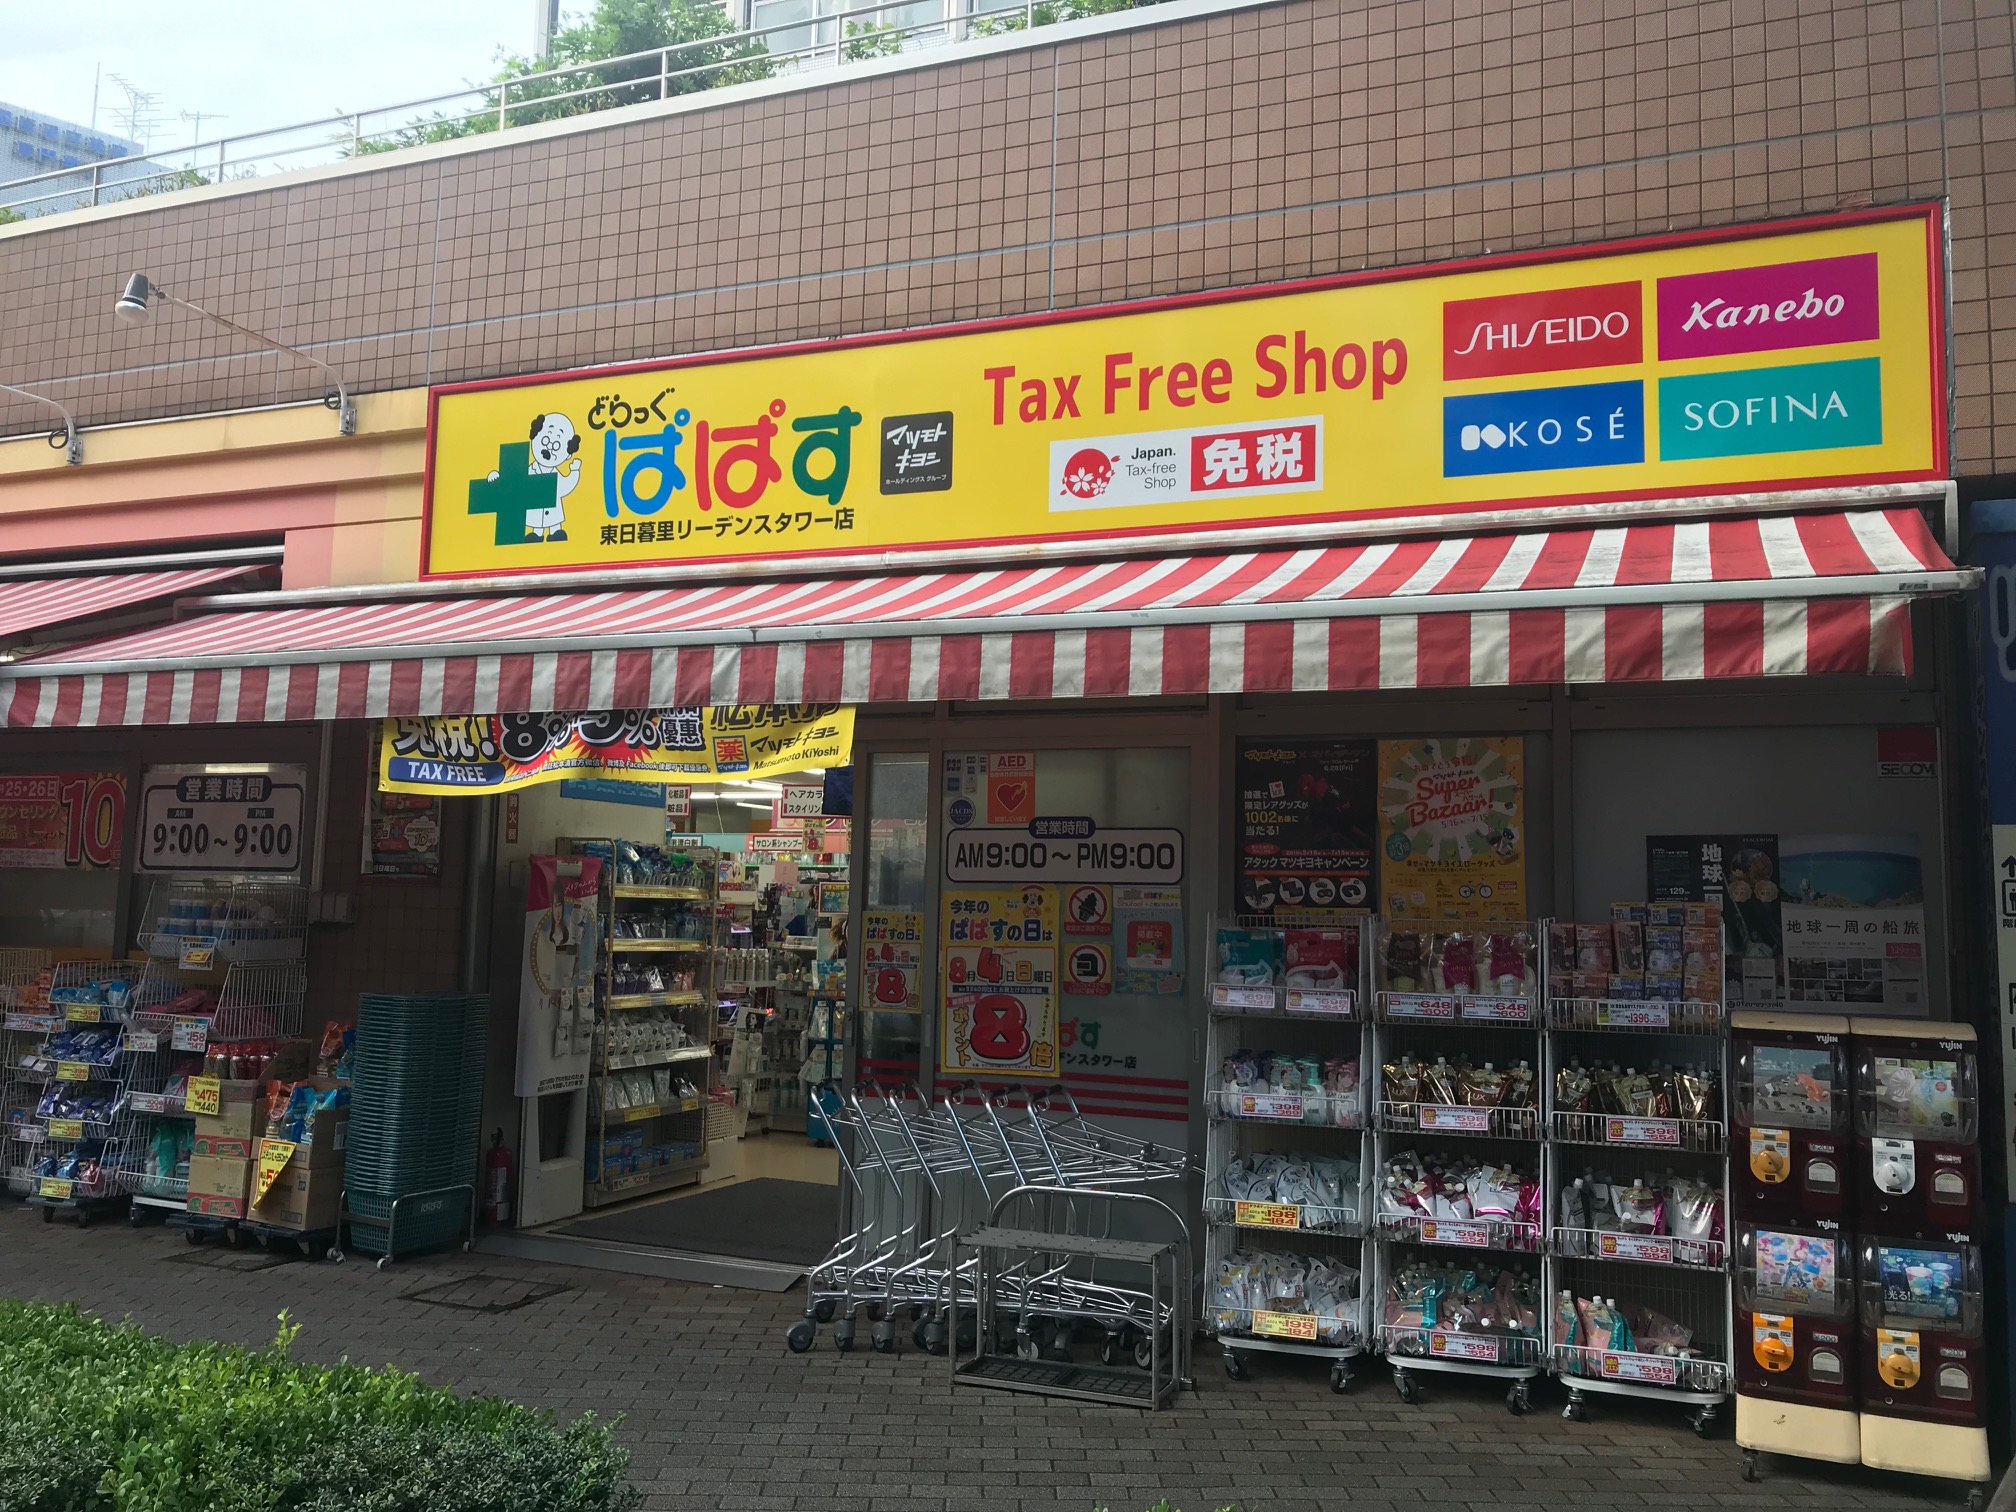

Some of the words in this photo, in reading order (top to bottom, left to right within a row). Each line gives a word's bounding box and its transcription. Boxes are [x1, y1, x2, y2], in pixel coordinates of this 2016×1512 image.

[1681, 288, 1845, 333] Kanebo
[1453, 311, 1629, 356] SHISEIDO
[984, 365, 1081, 425] Tax
[1104, 352, 1232, 415] Free
[1255, 330, 1407, 400] Shop
[587, 388, 675, 430] どらっぐ
[1685, 390, 1849, 432] SOFINA
[886, 422, 947, 450] マツモト
[1508, 407, 1626, 449] KOSÉ
[604, 398, 862, 518] ぱぱす
[895, 448, 941, 474] キヨシ
[1131, 445, 1177, 461] Japan.
[1203, 431, 1304, 486] 免税
[1125, 462, 1177, 476] Tax-free
[926, 474, 947, 482] グループ
[1144, 475, 1177, 491] Shop
[600, 507, 854, 546] 東日暮里リーデンスタワー店
[750, 726, 839, 755] マツモトキヨシ
[626, 760, 657, 770] Facebook
[753, 752, 801, 770] Matsumoto
[998, 755, 1027, 767] AED
[1881, 763, 1936, 775] SECOM
[408, 761, 443, 780] TAX
[447, 764, 487, 783] FREE
[185, 777, 264, 801] 営業時間
[1416, 775, 1480, 804] Super
[174, 809, 187, 817] AM
[255, 809, 266, 817] PM
[1244, 800, 1309, 810] 限定レアグッズが
[1405, 788, 1494, 828] Bazaar!
[507, 794, 518, 840] 消火器
[1035, 820, 1089, 836] 営業時間
[1244, 856, 1279, 868] アタック
[1279, 856, 1369, 868] マツキヨキャンペーン
[950, 898, 990, 914] 今年の
[867, 916, 888, 925] 今年の
[1786, 919, 1921, 935] 地球一周の船旅
[866, 926, 920, 940] ぱぱすの日は
[950, 917, 1053, 942] ぱぱすの日は
[1420, 1000, 1451, 1009] 648
[1495, 1003, 1527, 1012] 648
[970, 994, 1031, 1060] 8
[190, 1031, 205, 1042] 158
[953, 1006, 971, 1066] ポイント
[1029, 1040, 1054, 1068] 倍
[199, 1089, 218, 1102] 475
[200, 1102, 216, 1113] 440
[1275, 1103, 1301, 1111] 398
[1457, 1114, 1485, 1122] 598
[1645, 1127, 1676, 1135] 598
[1266, 1209, 1297, 1219] 198
[1457, 1230, 1486, 1238] 598
[1638, 1245, 1670, 1253] 598
[1641, 1252, 1668, 1260] 554
[1284, 1319, 1314, 1329] 198
[1288, 1328, 1313, 1336] 184
[1641, 1366, 1673, 1375] 598
